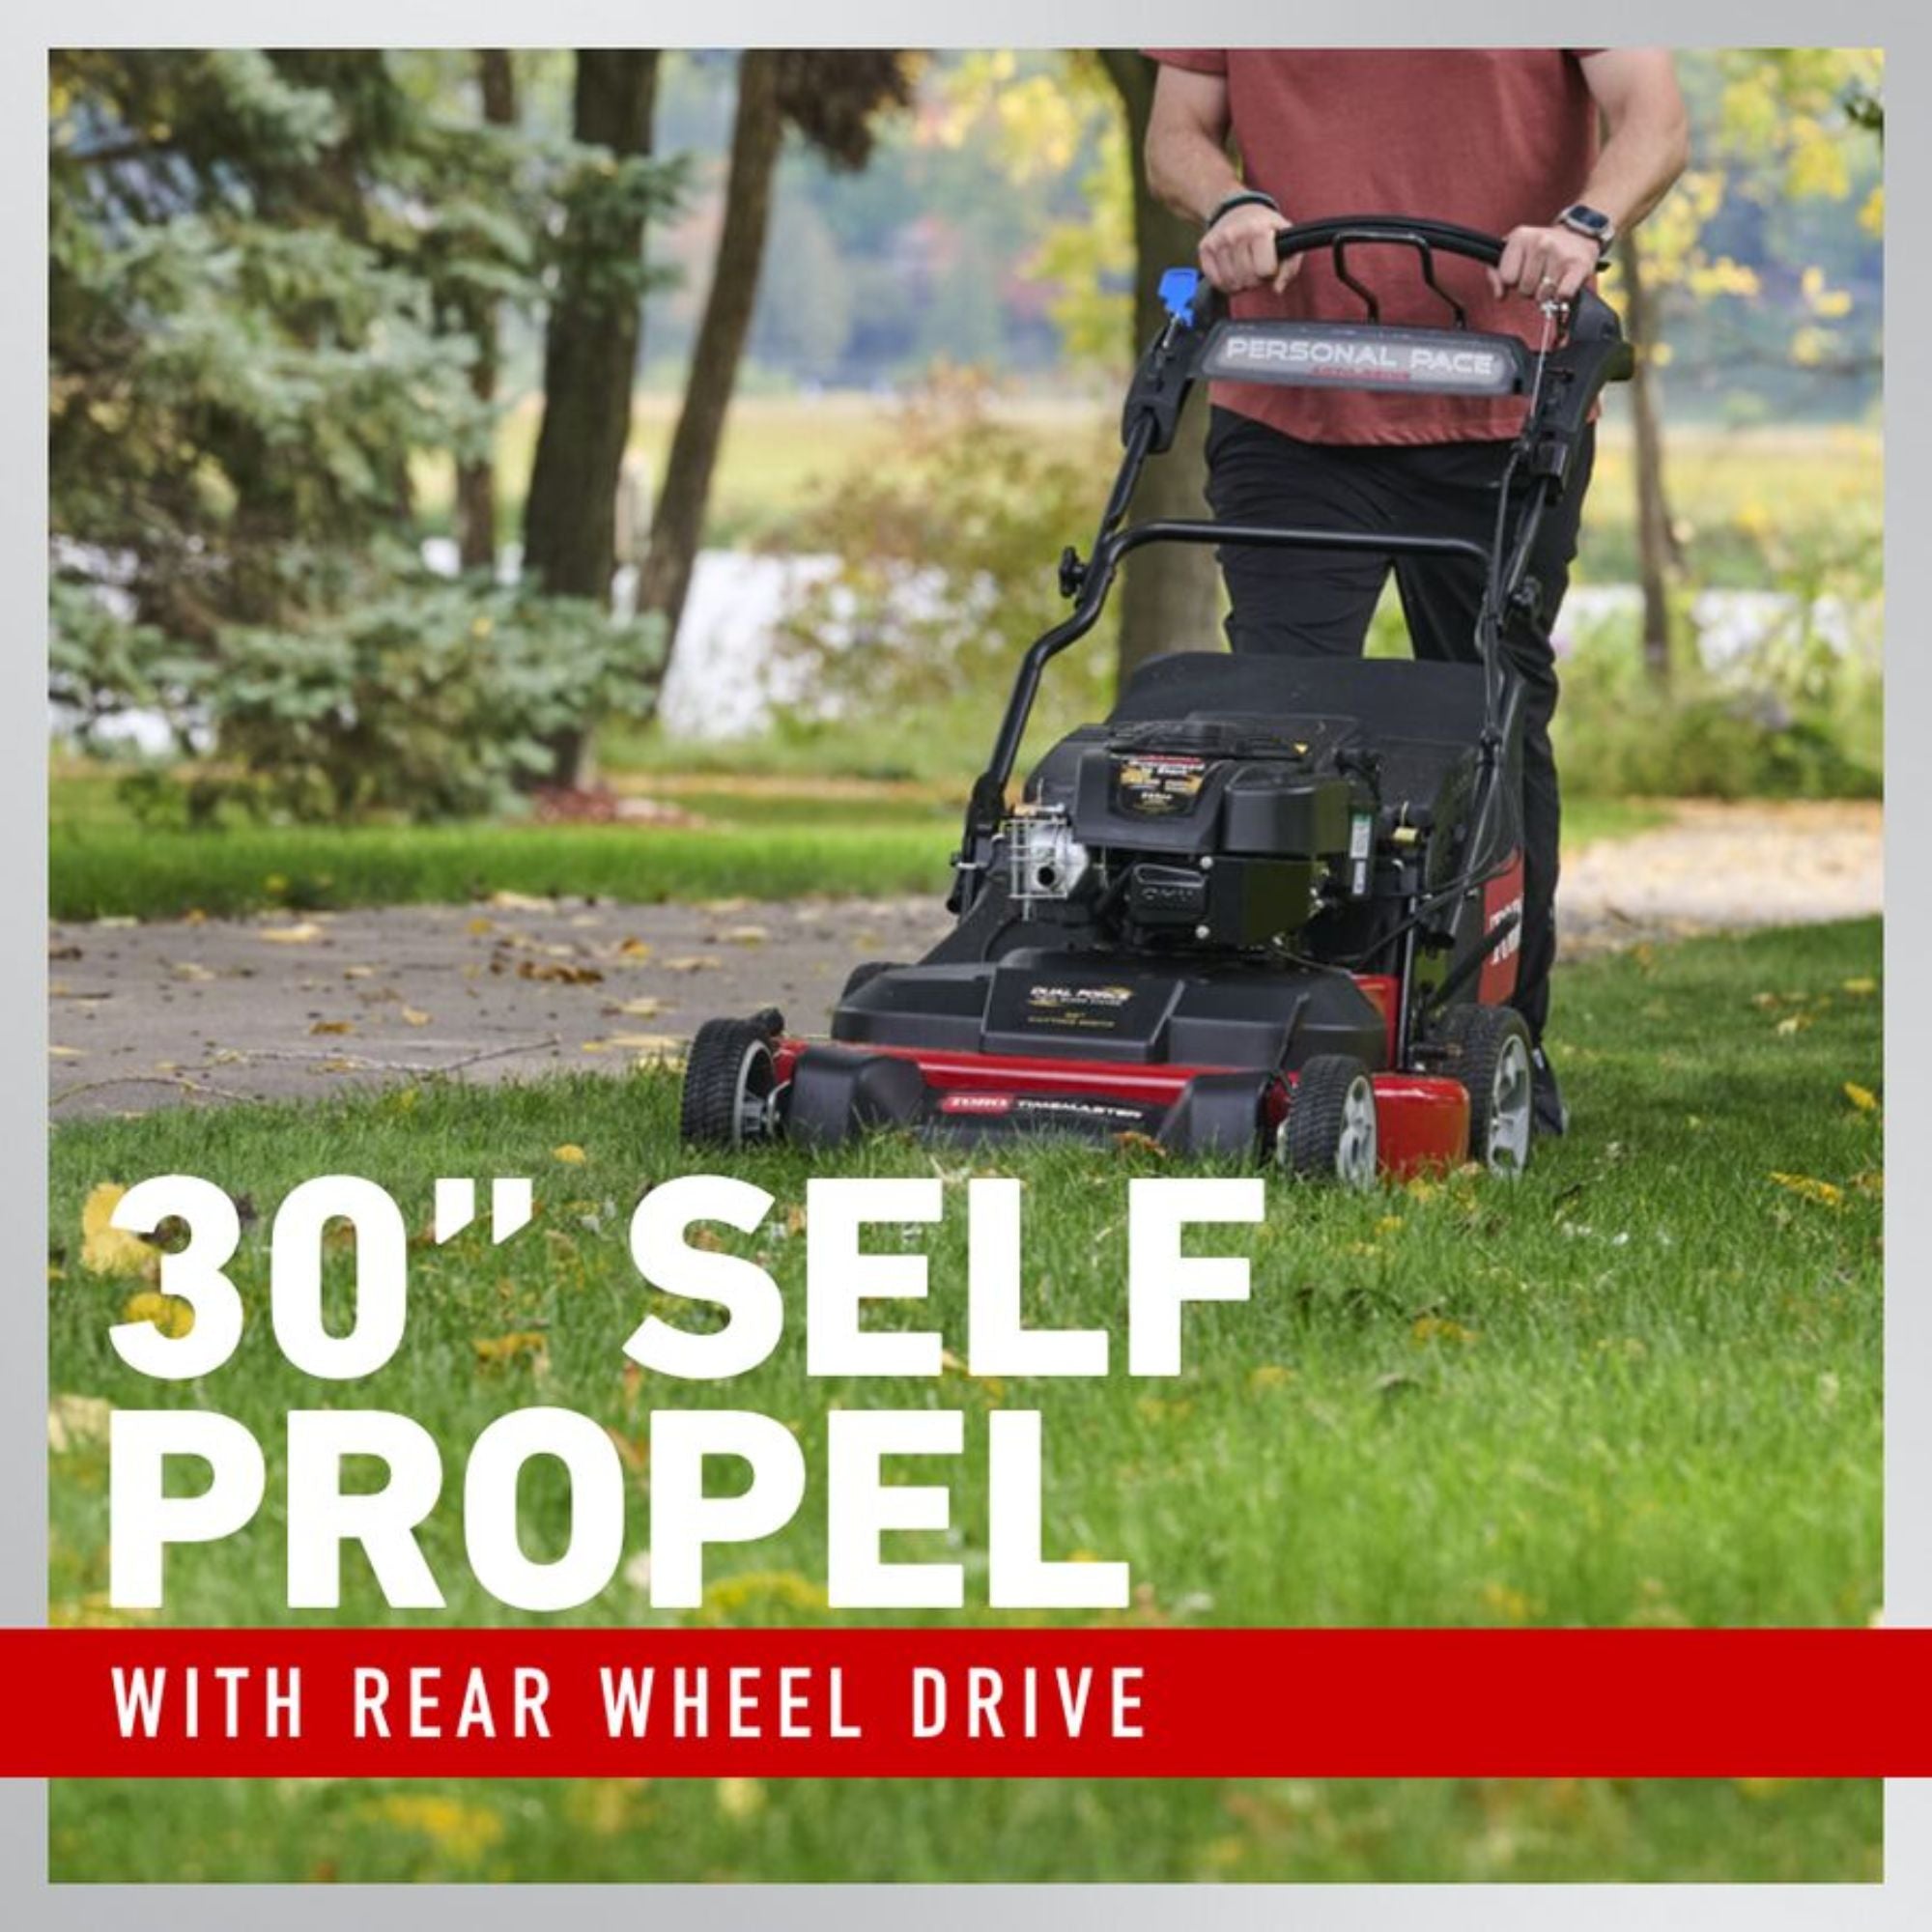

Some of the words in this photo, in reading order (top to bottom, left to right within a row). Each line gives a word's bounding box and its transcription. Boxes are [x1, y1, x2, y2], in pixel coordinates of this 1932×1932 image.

[1226, 336, 1398, 367] PERSONAL
[1409, 348, 1494, 376] PACE
[952, 1094, 1008, 1108] TORO
